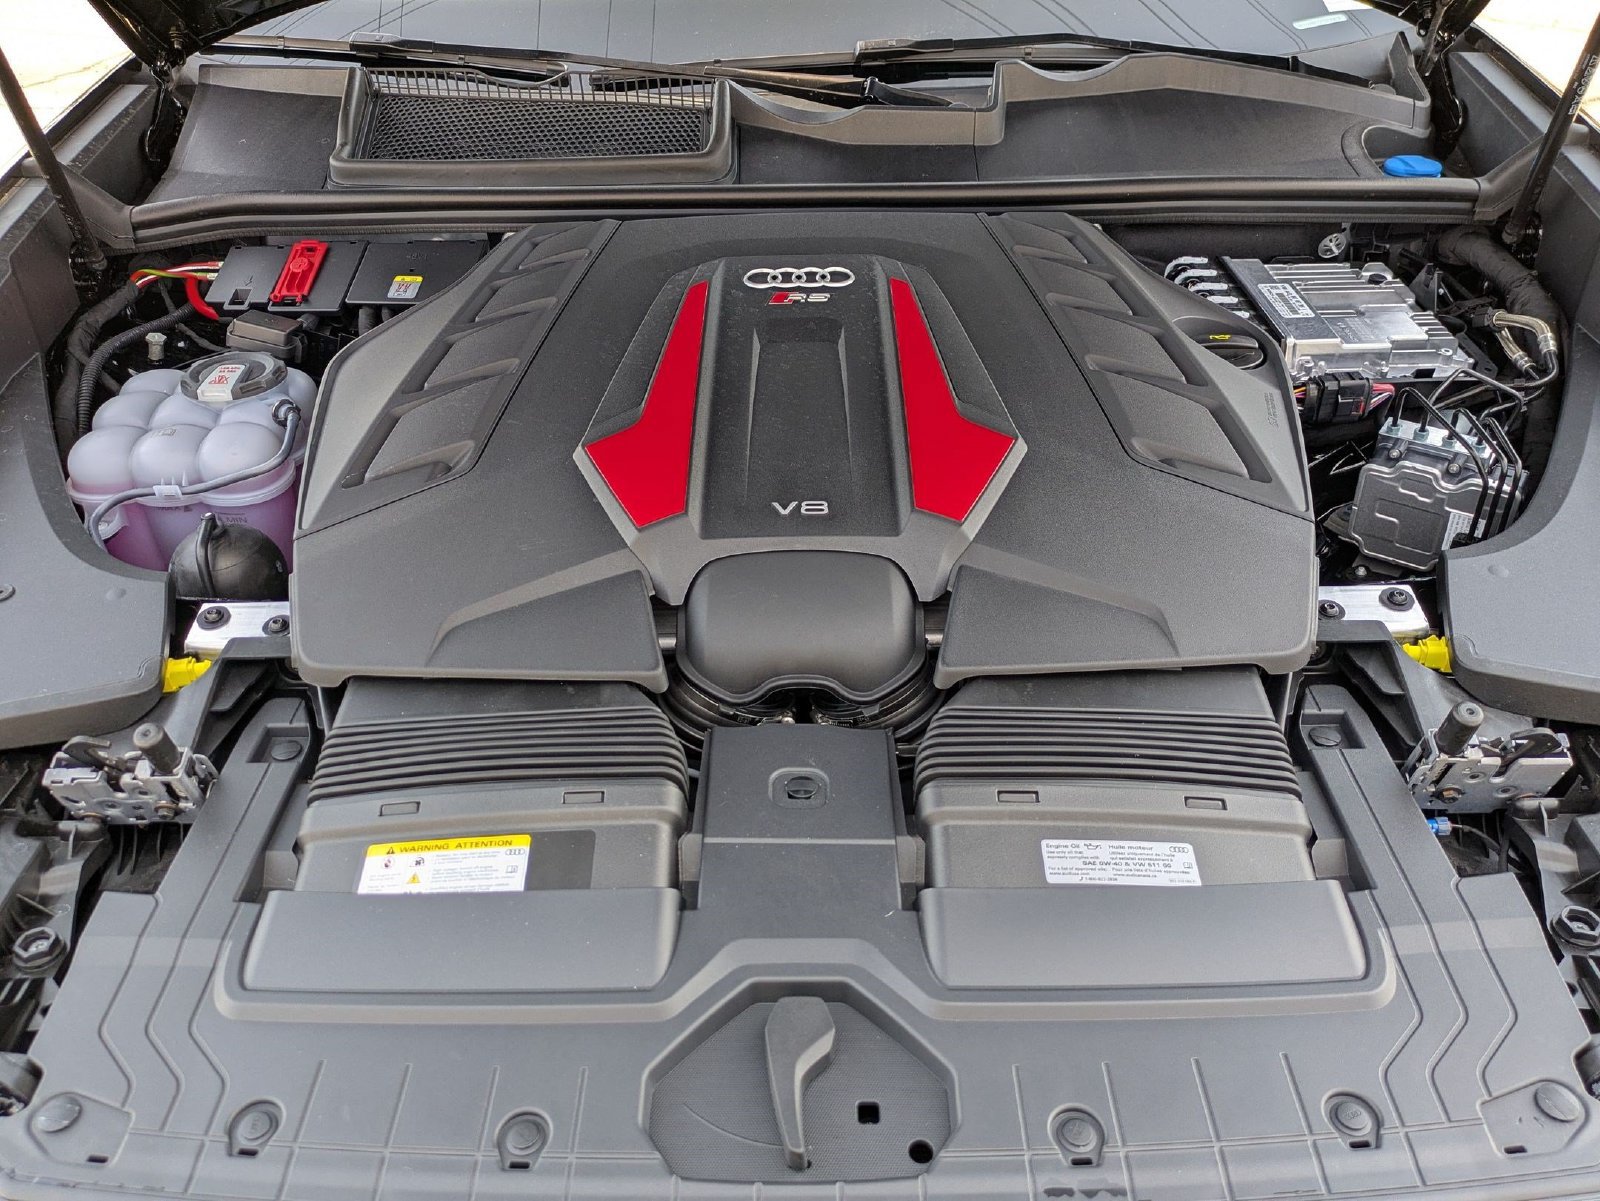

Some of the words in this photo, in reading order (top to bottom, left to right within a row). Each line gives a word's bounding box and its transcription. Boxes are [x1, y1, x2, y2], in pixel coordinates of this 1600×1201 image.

[782, 292, 831, 303] RS
[771, 500, 829, 515] V8
[400, 843, 449, 853] WARNING
[455, 840, 513, 849] ATTENTION
